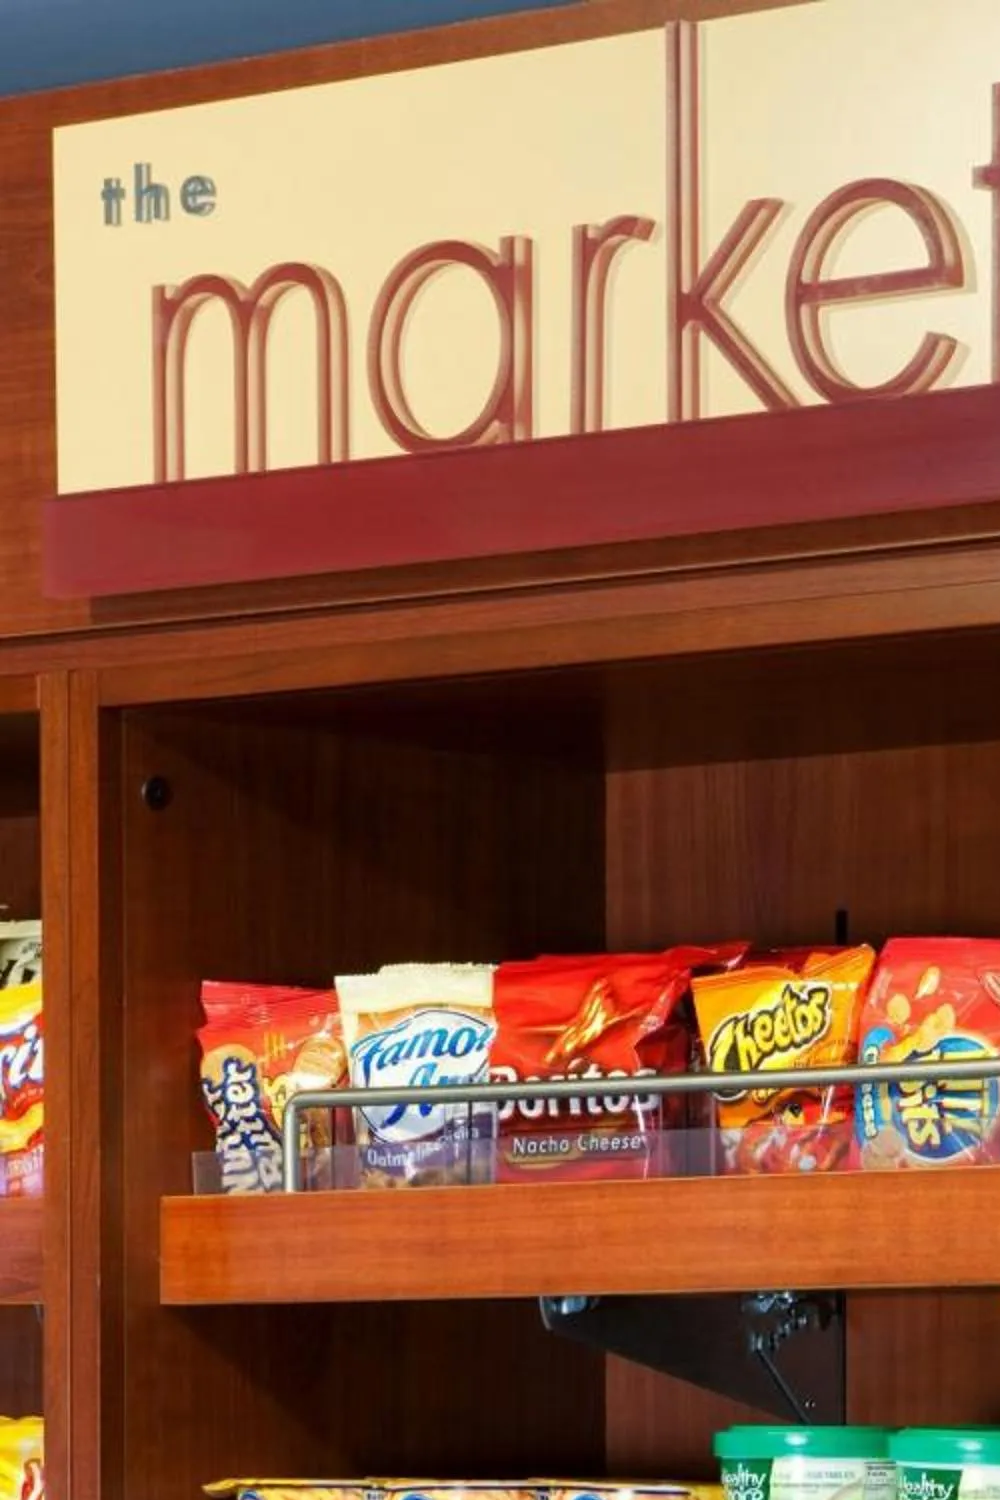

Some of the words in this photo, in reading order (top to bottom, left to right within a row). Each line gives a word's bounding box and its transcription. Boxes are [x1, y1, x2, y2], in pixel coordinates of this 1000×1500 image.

[100, 161, 216, 226] the
[711, 984, 829, 1098] Cheetos
[513, 1137, 569, 1155] Nacho
[577, 1134, 641, 1151] Cheese
